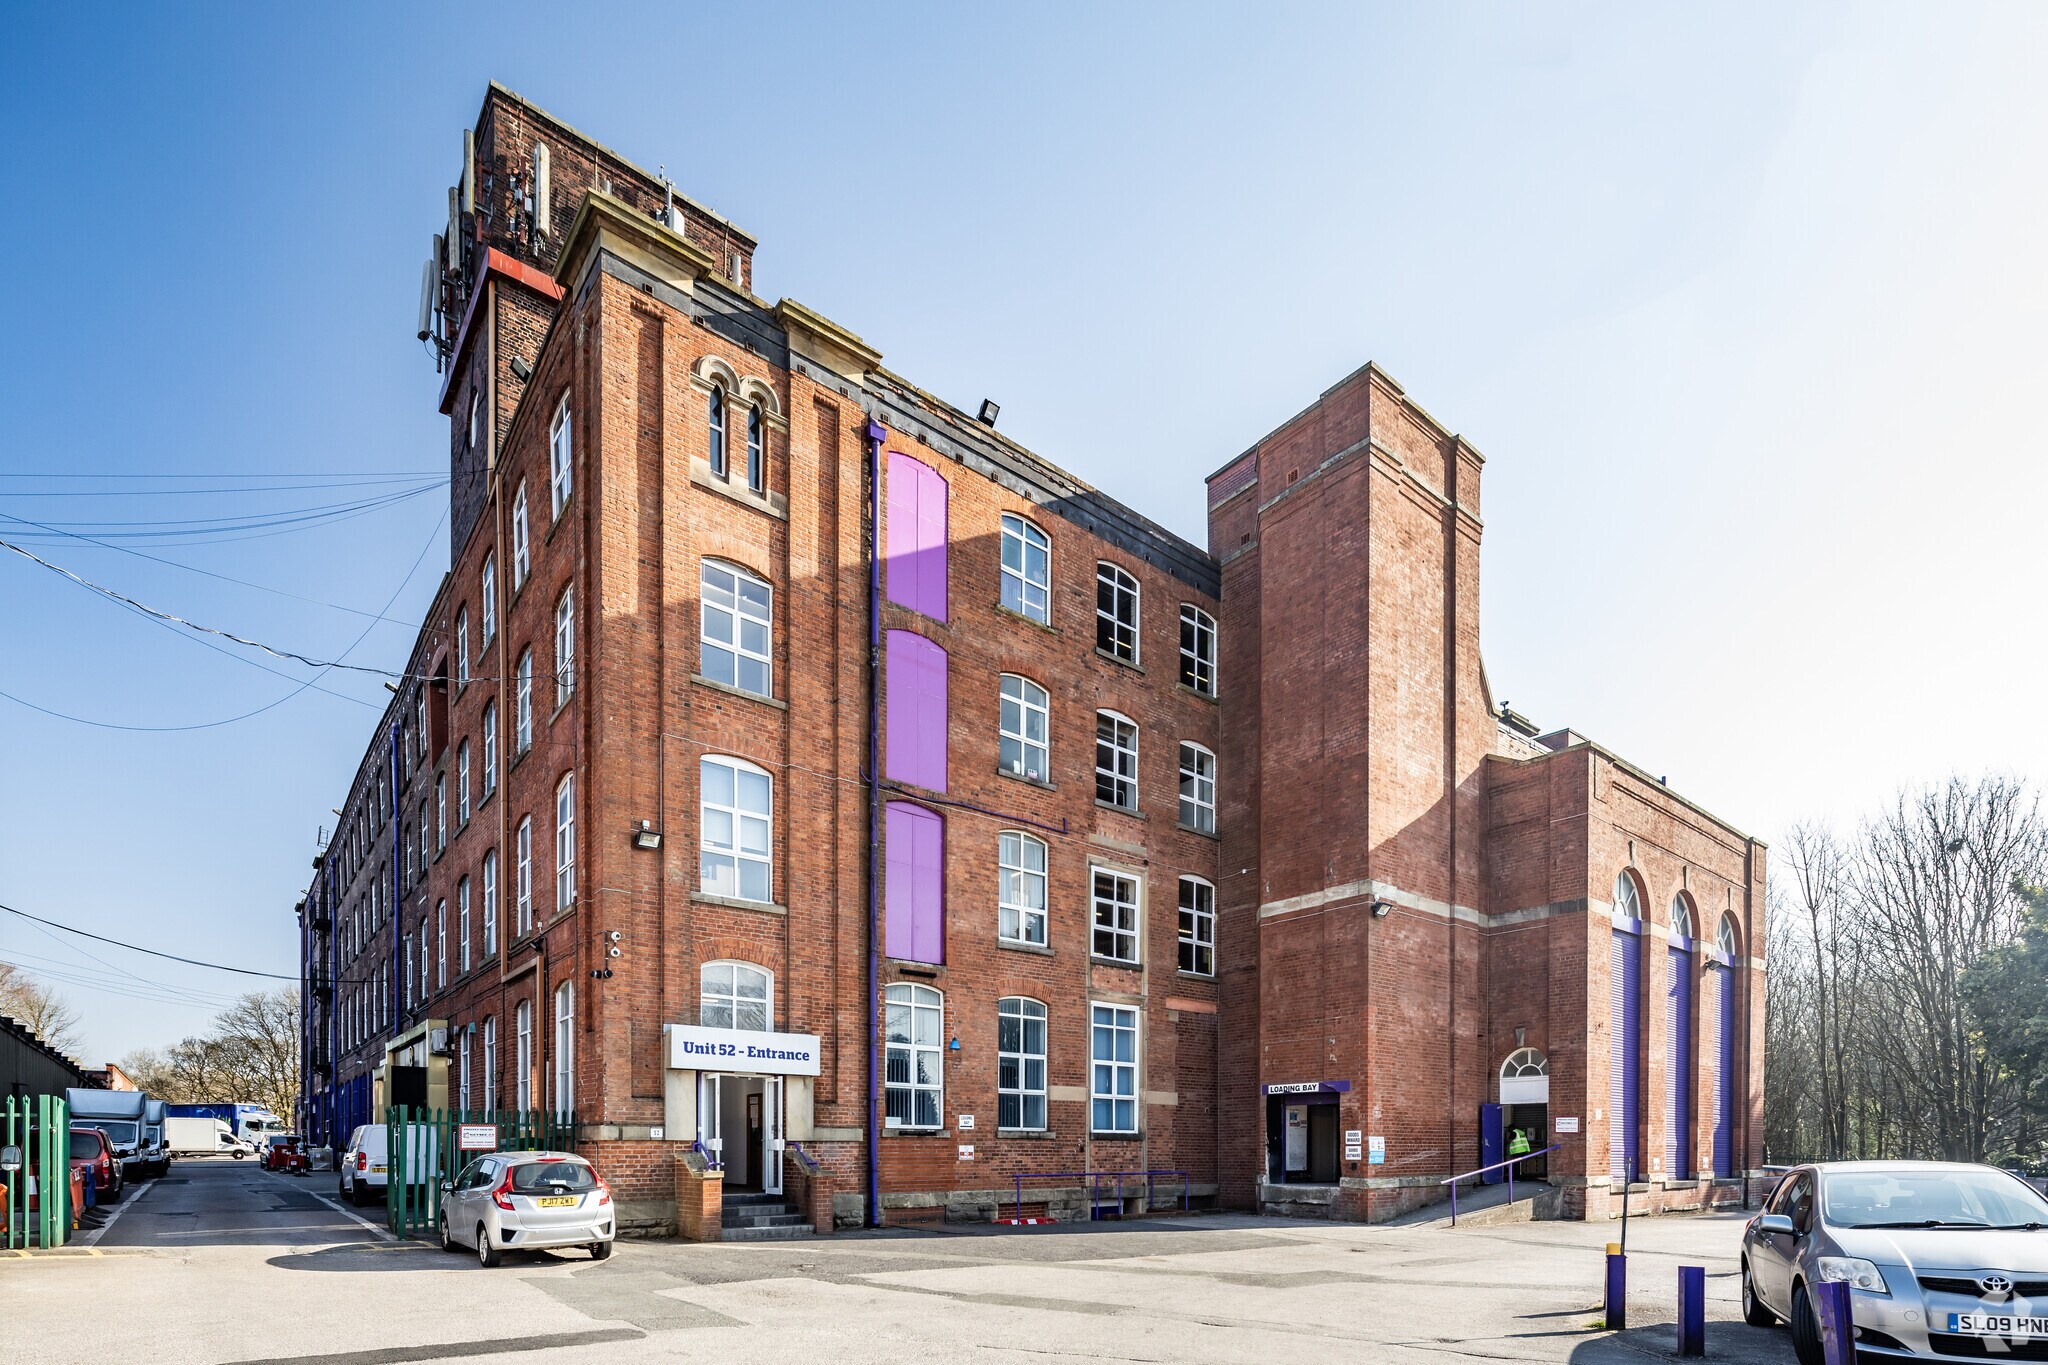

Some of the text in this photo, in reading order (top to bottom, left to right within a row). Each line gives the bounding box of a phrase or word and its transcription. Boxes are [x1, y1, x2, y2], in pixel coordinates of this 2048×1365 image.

[683, 1041, 716, 1055] Unit
[718, 1043, 736, 1056] 52
[747, 1045, 810, 1062] Entrance
[1270, 1083, 1317, 1093] LOADING BAY
[1960, 1315, 2011, 1332] SL09
